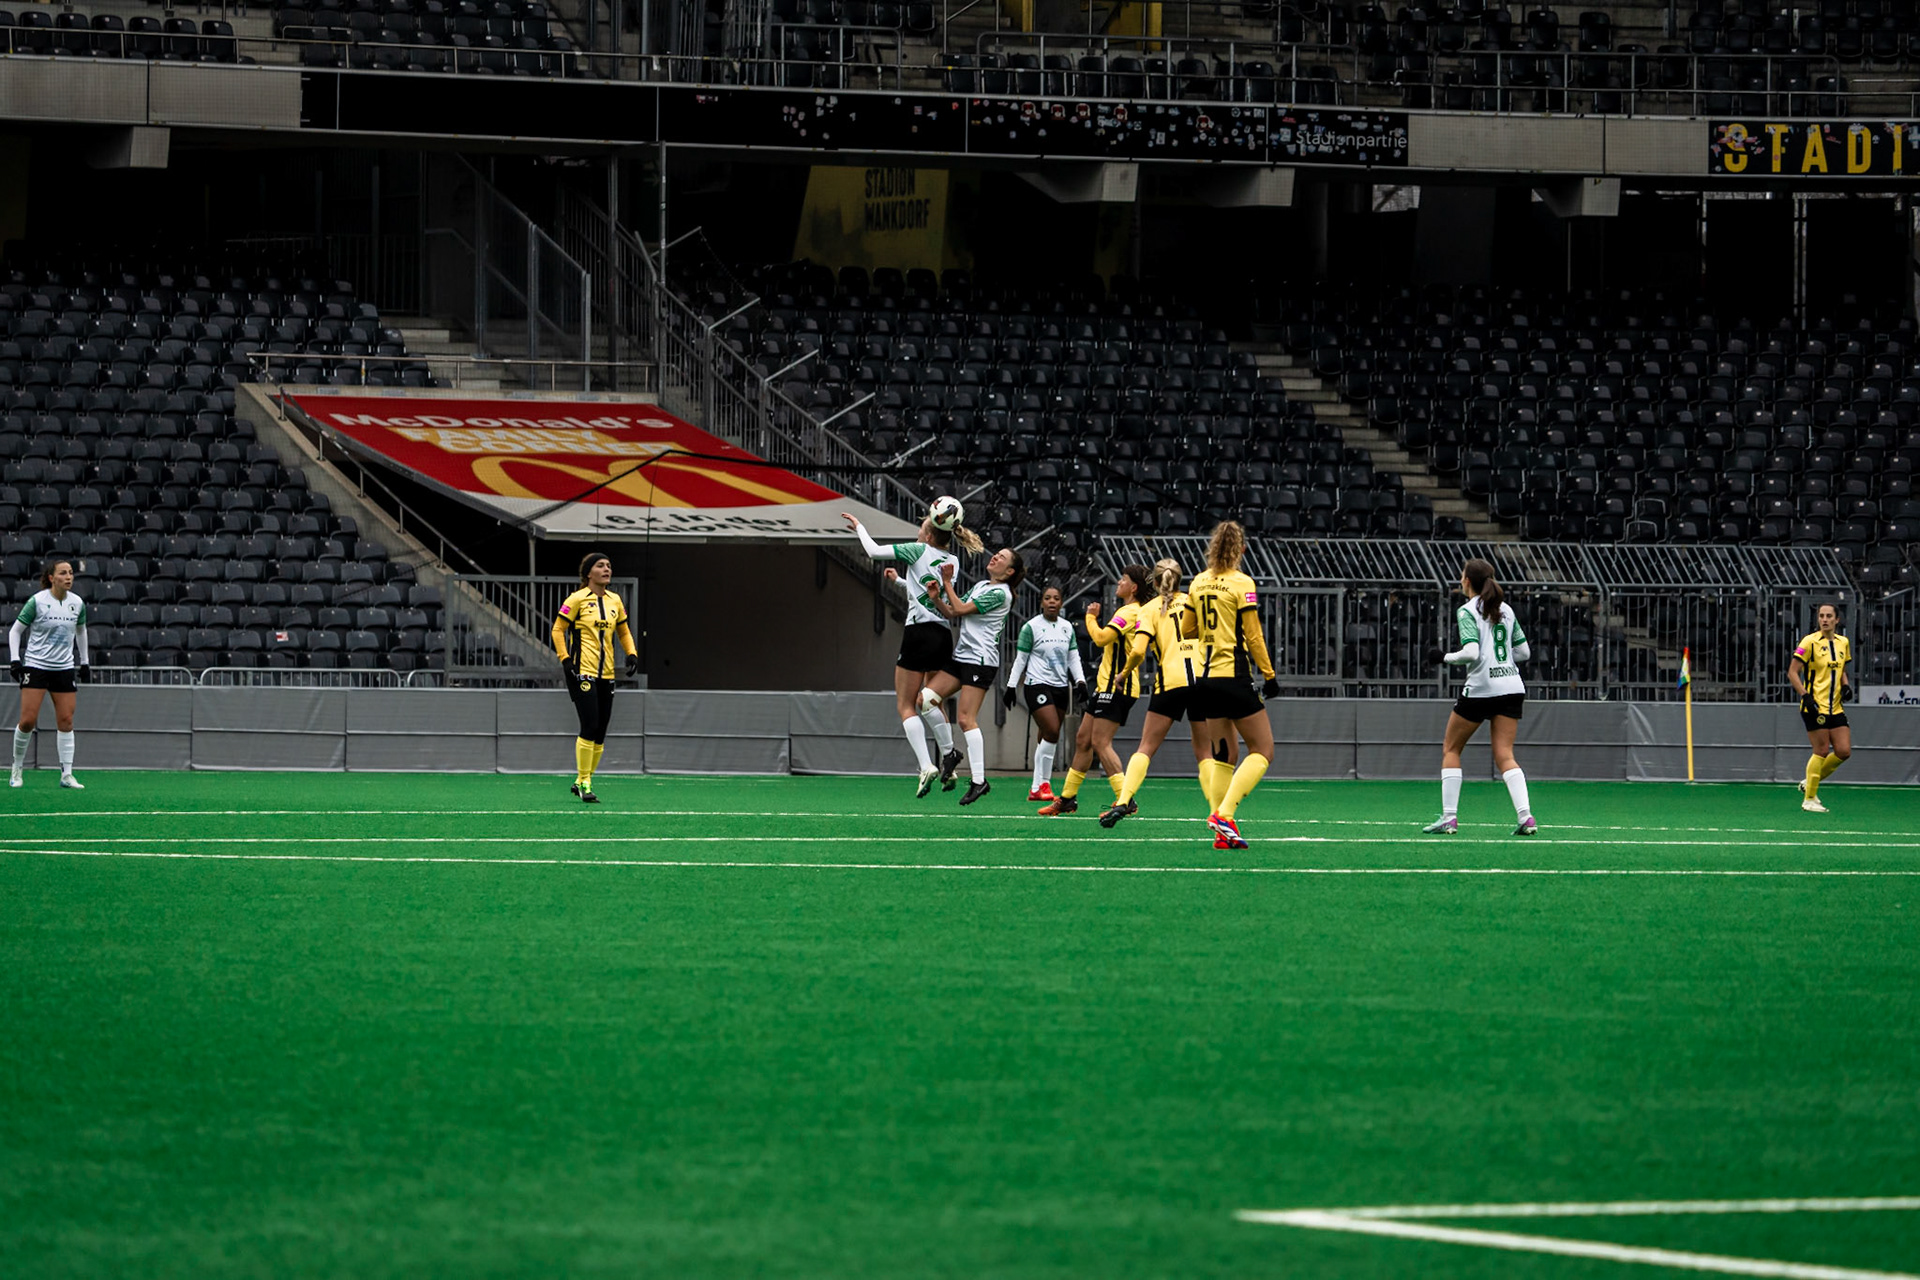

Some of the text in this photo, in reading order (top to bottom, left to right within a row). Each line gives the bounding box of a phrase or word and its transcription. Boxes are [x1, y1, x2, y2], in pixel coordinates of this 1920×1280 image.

[865, 167, 916, 198] STADION
[329, 413, 674, 429] McDonald's
[396, 428, 598, 442] FAMILY
[437, 440, 677, 456] CORNER
[724, 516, 791, 526] der
[1199, 594, 1218, 631] 15
[1492, 623, 1508, 664] 8
